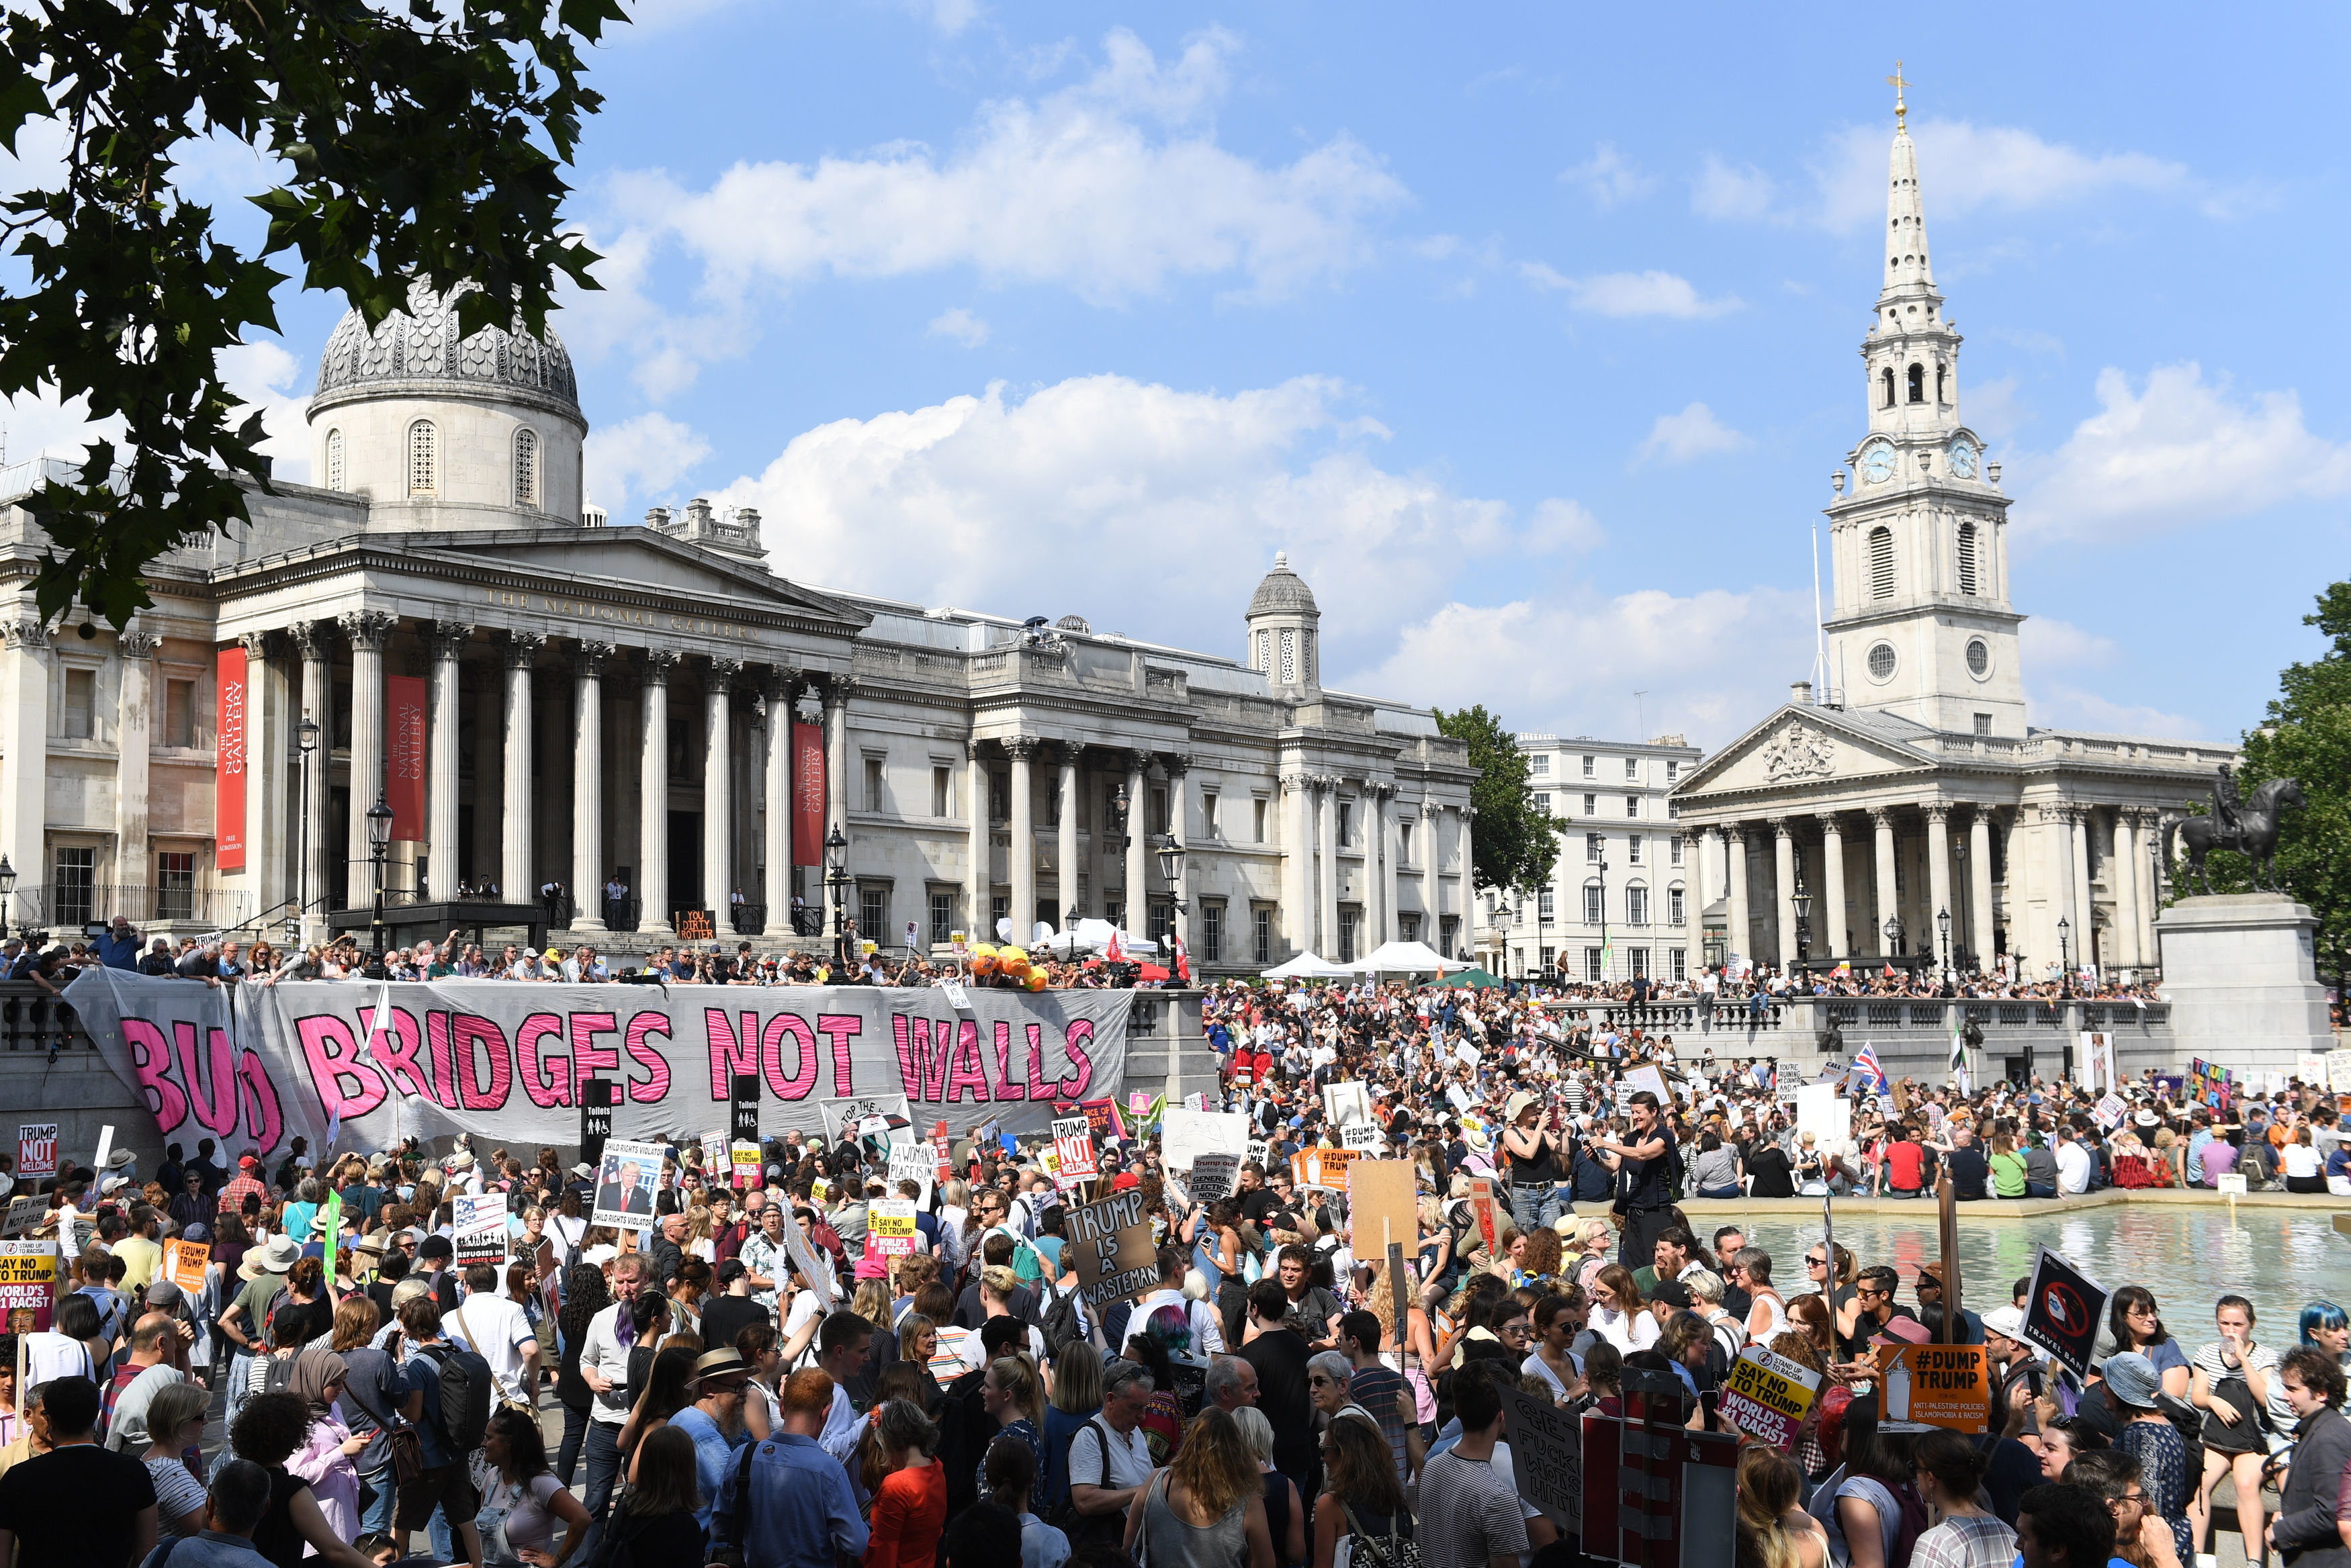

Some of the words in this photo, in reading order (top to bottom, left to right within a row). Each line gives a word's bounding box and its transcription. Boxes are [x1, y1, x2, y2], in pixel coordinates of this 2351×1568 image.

[484, 589, 529, 608] THE
[544, 597, 656, 627] NATIONAL
[671, 616, 760, 642] GALLERY
[232, 680, 242, 774] GALLERY
[398, 703, 408, 778] NATIONAL
[409, 704, 420, 780] GALLERY
[803, 746, 811, 812] NATIONAL
[811, 746, 821, 813] GALLERY
[219, 843, 242, 852] ADMISSION
[688, 911, 704, 920] YOU
[683, 919, 710, 930] DIRTY
[196, 933, 222, 946] TRUMP
[681, 929, 714, 940] ROTTER
[294, 1005, 672, 1122] BRIDGES
[704, 1007, 862, 1101] NOT
[891, 1012, 1094, 1104] WALLS
[1779, 1063, 1798, 1071] YOU'RE
[1826, 1062, 1840, 1070] CALL
[2194, 1058, 2232, 1082] TRUMP
[1779, 1084, 1791, 1092] AND
[2190, 1083, 2231, 1111] FART
[587, 1107, 611, 1115] Toilets
[738, 1101, 758, 1110] Toilets
[858, 1101, 876, 1113] THE
[1083, 1108, 1098, 1117] OICE
[21, 1126, 56, 1140] TRUMP
[1053, 1119, 1087, 1138] TRUMP
[1345, 1125, 1376, 1137] #DUMP
[1346, 1135, 1375, 1146] TRUMP
[21, 1139, 54, 1162] NOT
[605, 1143, 619, 1152] CHILD
[620, 1144, 638, 1154] RIGHTS
[639, 1146, 664, 1156] VIOLATOR
[891, 1147, 901, 1162] A
[903, 1146, 936, 1166] WOMAN'S
[1057, 1136, 1092, 1164] NOT
[1047, 1156, 1056, 1164] NO
[1323, 1152, 1356, 1161] #DUMP
[21, 1160, 54, 1171] WELCOME
[890, 1165, 914, 1179] PLACE
[917, 1166, 924, 1178] IS
[925, 1165, 932, 1177] IN
[1061, 1160, 1096, 1175] WELCOME
[1193, 1176, 1232, 1184] GENERAL
[1191, 1184, 1231, 1193] ELECTION
[1198, 1192, 1222, 1201] NOW!
[13, 1201, 28, 1211] IT'S
[7, 1217, 24, 1229] NOT
[593, 1213, 608, 1221] CHILD
[609, 1215, 626, 1224] RIGHTS
[627, 1216, 653, 1227] VIOLATOR
[879, 1219, 891, 1227] SAY
[1065, 1190, 1143, 1244] TRUMP
[889, 1228, 912, 1236] TRUMP
[878, 1238, 908, 1246] WORLD'S
[1096, 1234, 1118, 1259] IS
[181, 1245, 206, 1258] #DUMP
[877, 1246, 886, 1254] #1
[887, 1246, 912, 1255] RACIST
[21, 1258, 36, 1269] NO
[180, 1256, 203, 1269] TRUMP
[1100, 1257, 1118, 1275] A
[13, 1270, 52, 1280] TRUMP
[1081, 1262, 1162, 1306] WASTEMAN
[9, 1297, 50, 1308] RACIST
[2041, 1324, 2057, 1338] BIN
[2061, 1339, 2076, 1353] THE
[2028, 1324, 2061, 1354] TRAVEL
[2064, 1351, 2083, 1371] BAN
[1774, 1357, 1793, 1371] STAND
[1916, 1350, 1980, 1370] #DUMP
[1738, 1363, 1767, 1384] SAY
[1767, 1375, 1788, 1394] NO
[1772, 1363, 1780, 1371] TO
[1780, 1367, 1803, 1382] RACISM
[1917, 1371, 1979, 1389] TRUMP
[1734, 1374, 1753, 1393] TO
[1755, 1385, 1803, 1415] TRUMP
[1726, 1391, 1787, 1430] WORLD'S
[1914, 1402, 1959, 1410] ANTI-PALESTINE
[1738, 1414, 1789, 1444] RACIST
